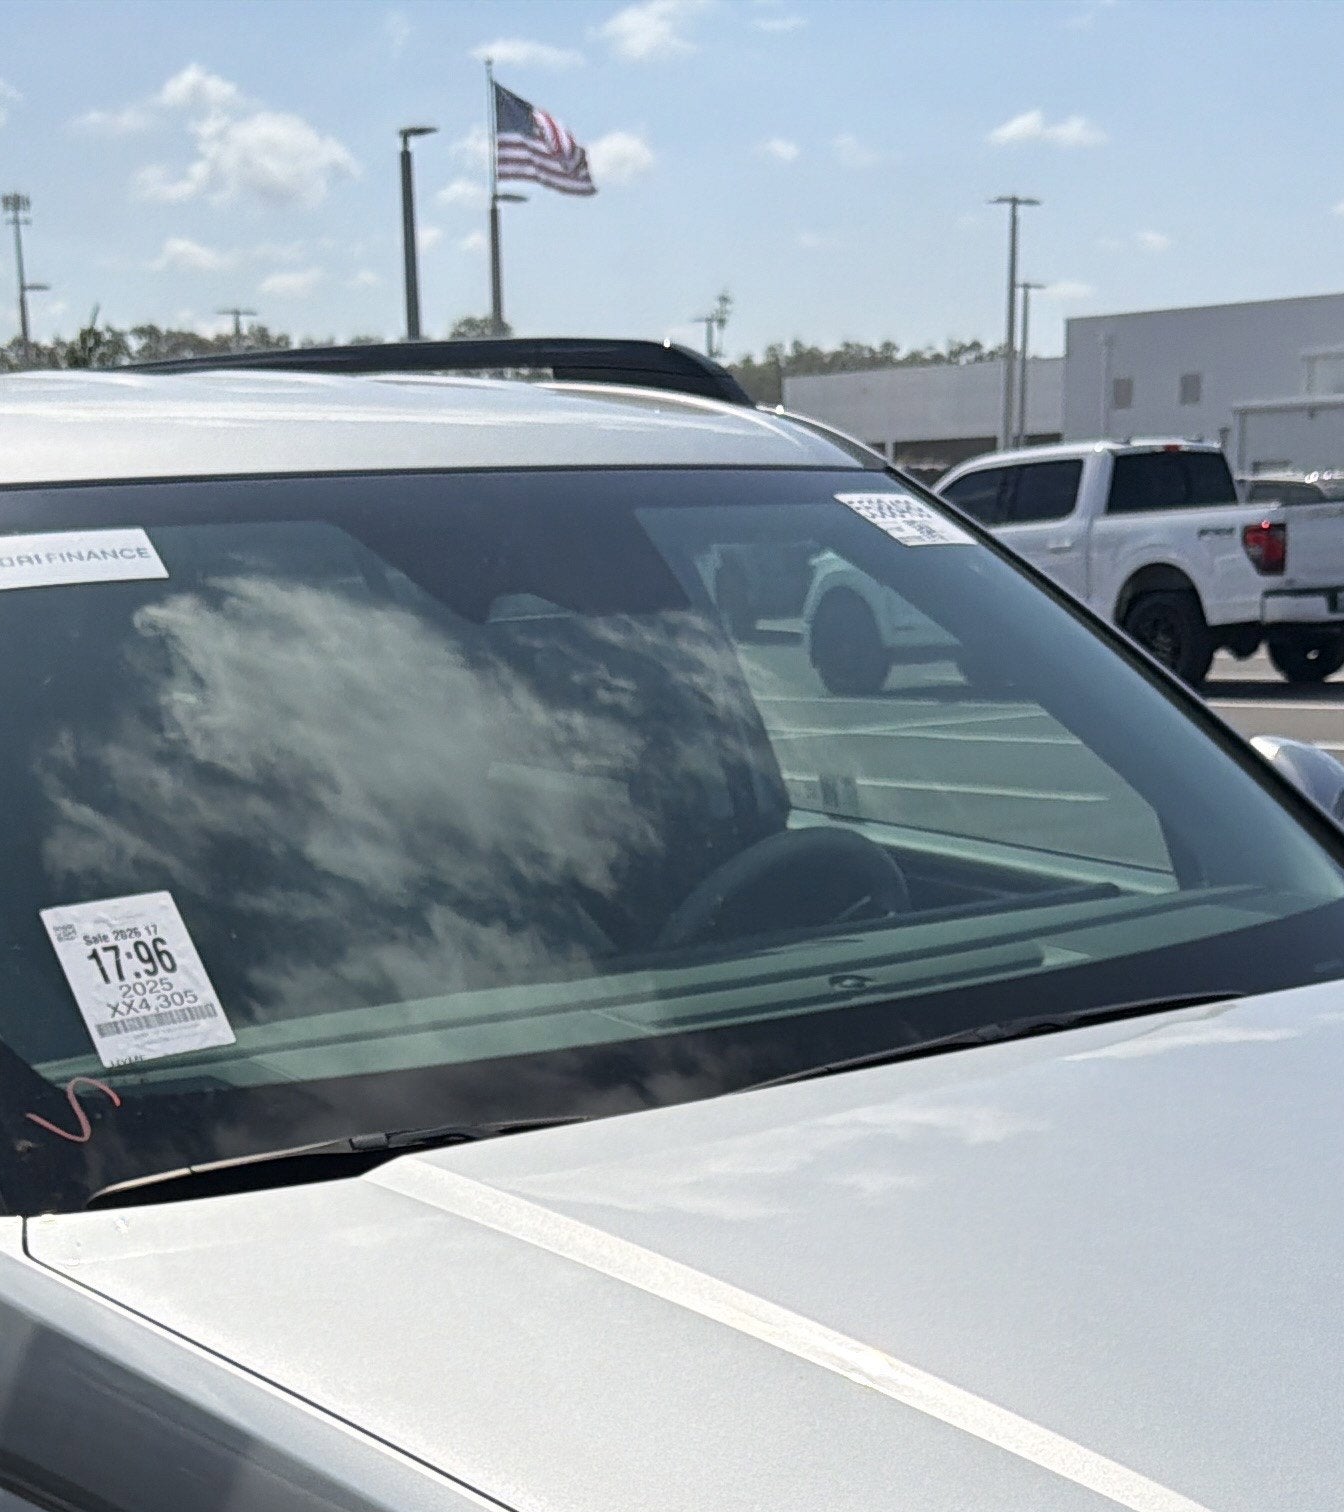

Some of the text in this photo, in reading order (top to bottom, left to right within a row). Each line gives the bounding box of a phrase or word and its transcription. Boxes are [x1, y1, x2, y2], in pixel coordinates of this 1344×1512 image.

[45, 546, 152, 566] FINANCE
[82, 933, 110, 946] Sale
[118, 976, 174, 999] 2025
